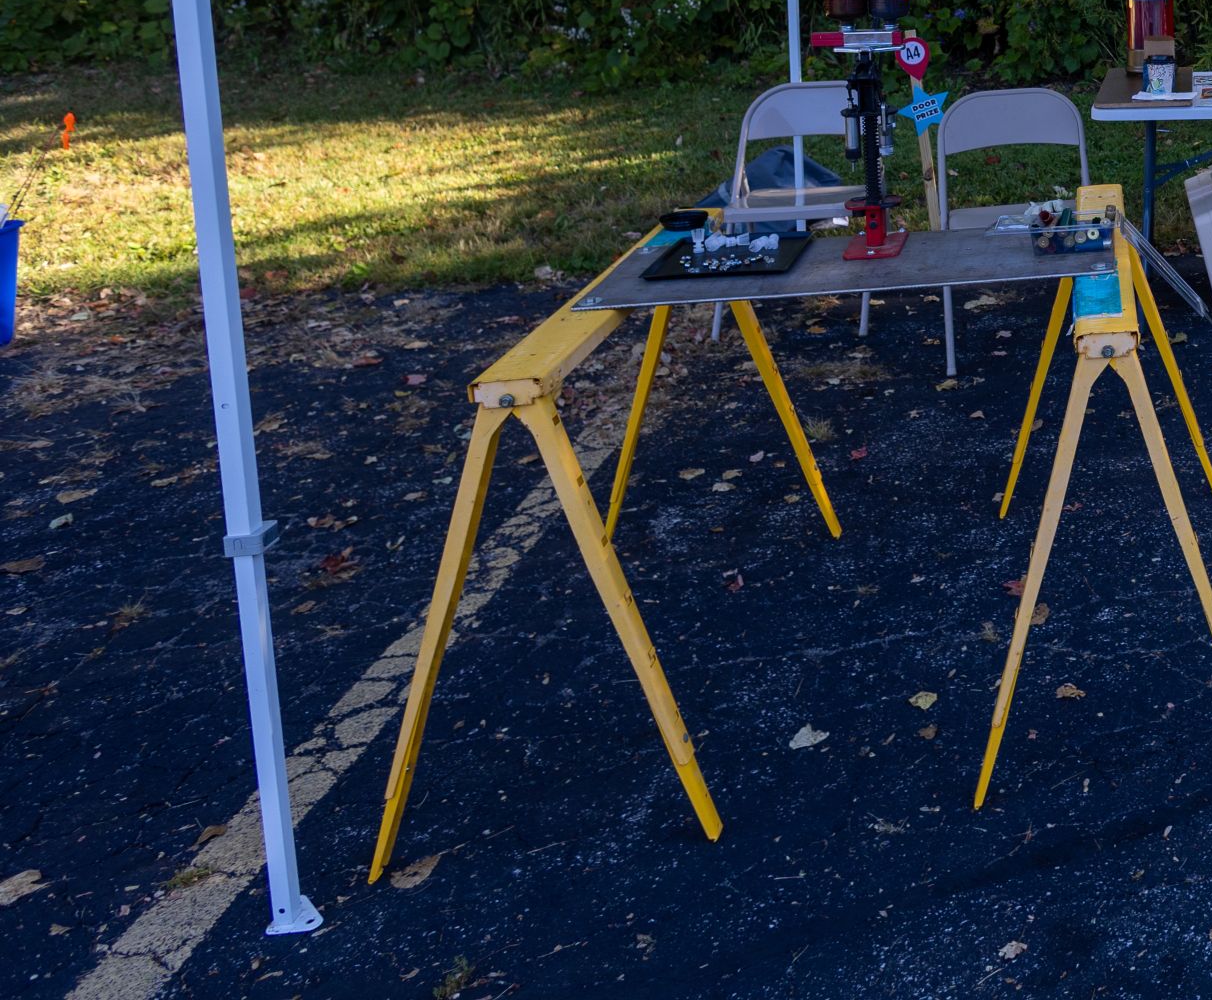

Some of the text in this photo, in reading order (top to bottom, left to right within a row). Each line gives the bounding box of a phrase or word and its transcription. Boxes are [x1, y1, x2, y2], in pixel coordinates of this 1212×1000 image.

[906, 46, 920, 60] A4
[912, 99, 936, 112] DOOR
[916, 107, 940, 120] PRIZE
